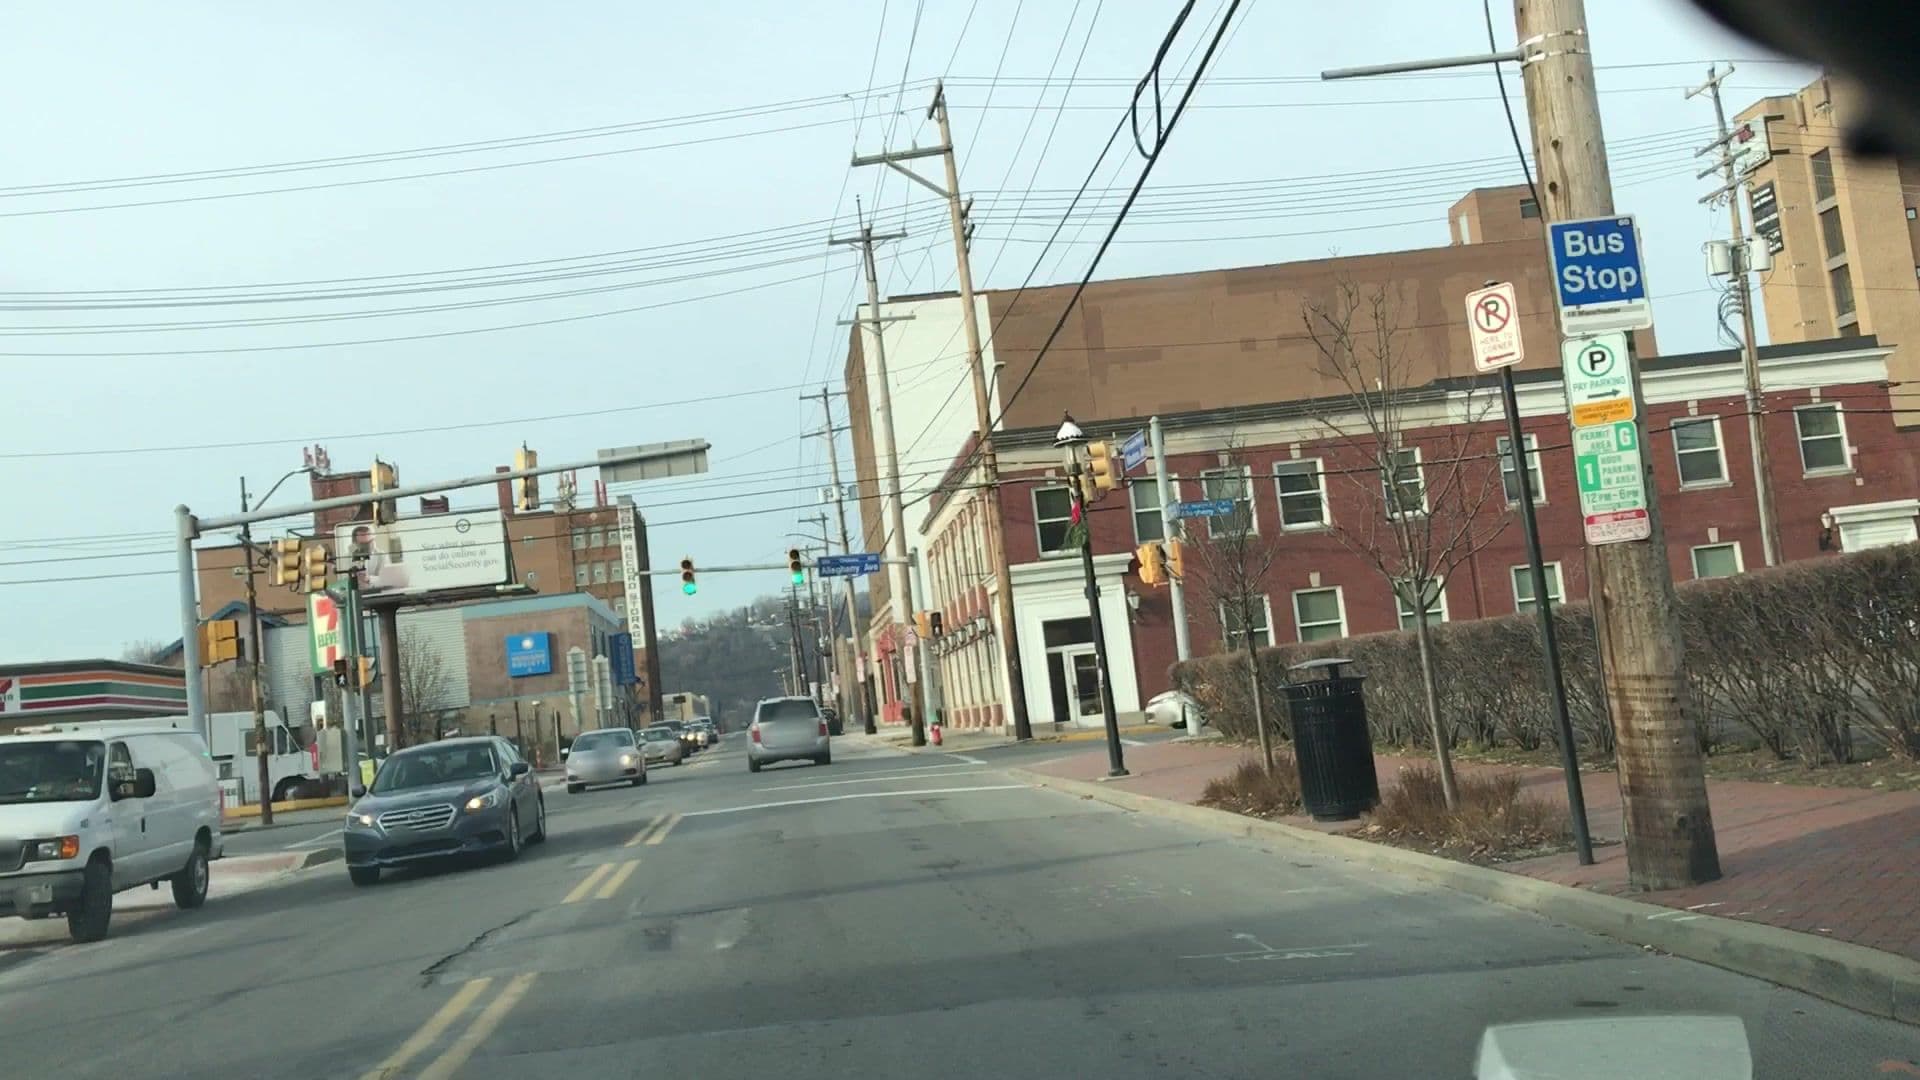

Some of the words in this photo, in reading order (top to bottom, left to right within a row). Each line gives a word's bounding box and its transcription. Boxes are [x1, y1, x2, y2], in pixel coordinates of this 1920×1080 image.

[1563, 230, 1624, 257] Bus
[1562, 265, 1637, 293] Stop
[1589, 350, 1607, 371] P
[1572, 382, 1587, 391] PAY
[1590, 376, 1626, 388] PARKING
[1580, 431, 1609, 441] PERMIT
[1618, 427, 1632, 447] G
[1590, 440, 1612, 450] AREA
[1601, 455, 1622, 465] HOUR
[1583, 462, 1594, 485] 1
[1602, 464, 1636, 475] PARKING
[1615, 475, 1636, 485] AREA
[821, 565, 860, 576] Allegheny
[863, 563, 879, 572] Ave
[629, 592, 642, 646] STORAGE
